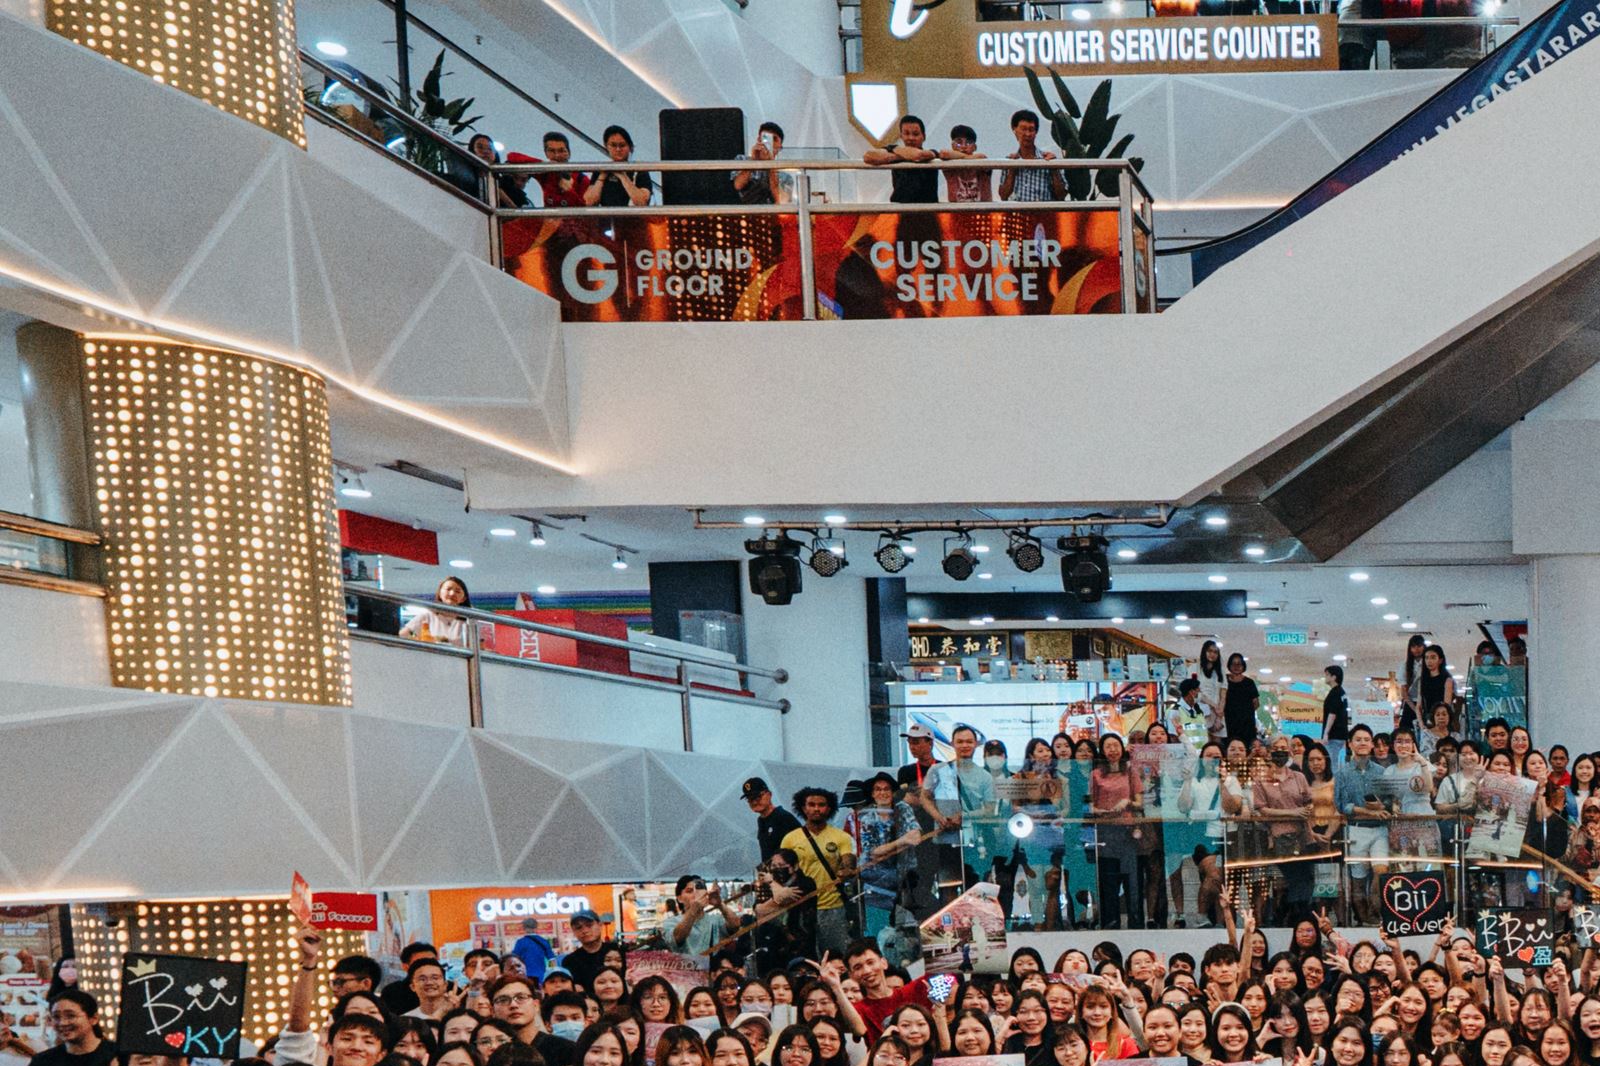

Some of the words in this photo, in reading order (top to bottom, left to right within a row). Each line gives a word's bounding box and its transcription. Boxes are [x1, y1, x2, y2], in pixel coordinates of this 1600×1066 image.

[978, 30, 1105, 66] CUSTOMER
[1110, 27, 1207, 63] SERVICE
[1213, 25, 1321, 60] COUNTER
[635, 248, 753, 270] GROUND
[869, 239, 1062, 269] CUSTOMER
[561, 243, 618, 304] G
[637, 275, 724, 296] FLOOR
[896, 272, 1039, 302] SERVICE
[940, 636, 1002, 657] 恭和堂
[477, 892, 590, 921] guardian
[1394, 889, 1427, 911] Bii
[1499, 917, 1553, 956] Bii
[128, 972, 237, 1035] Bii
[183, 1025, 238, 1055] KY
